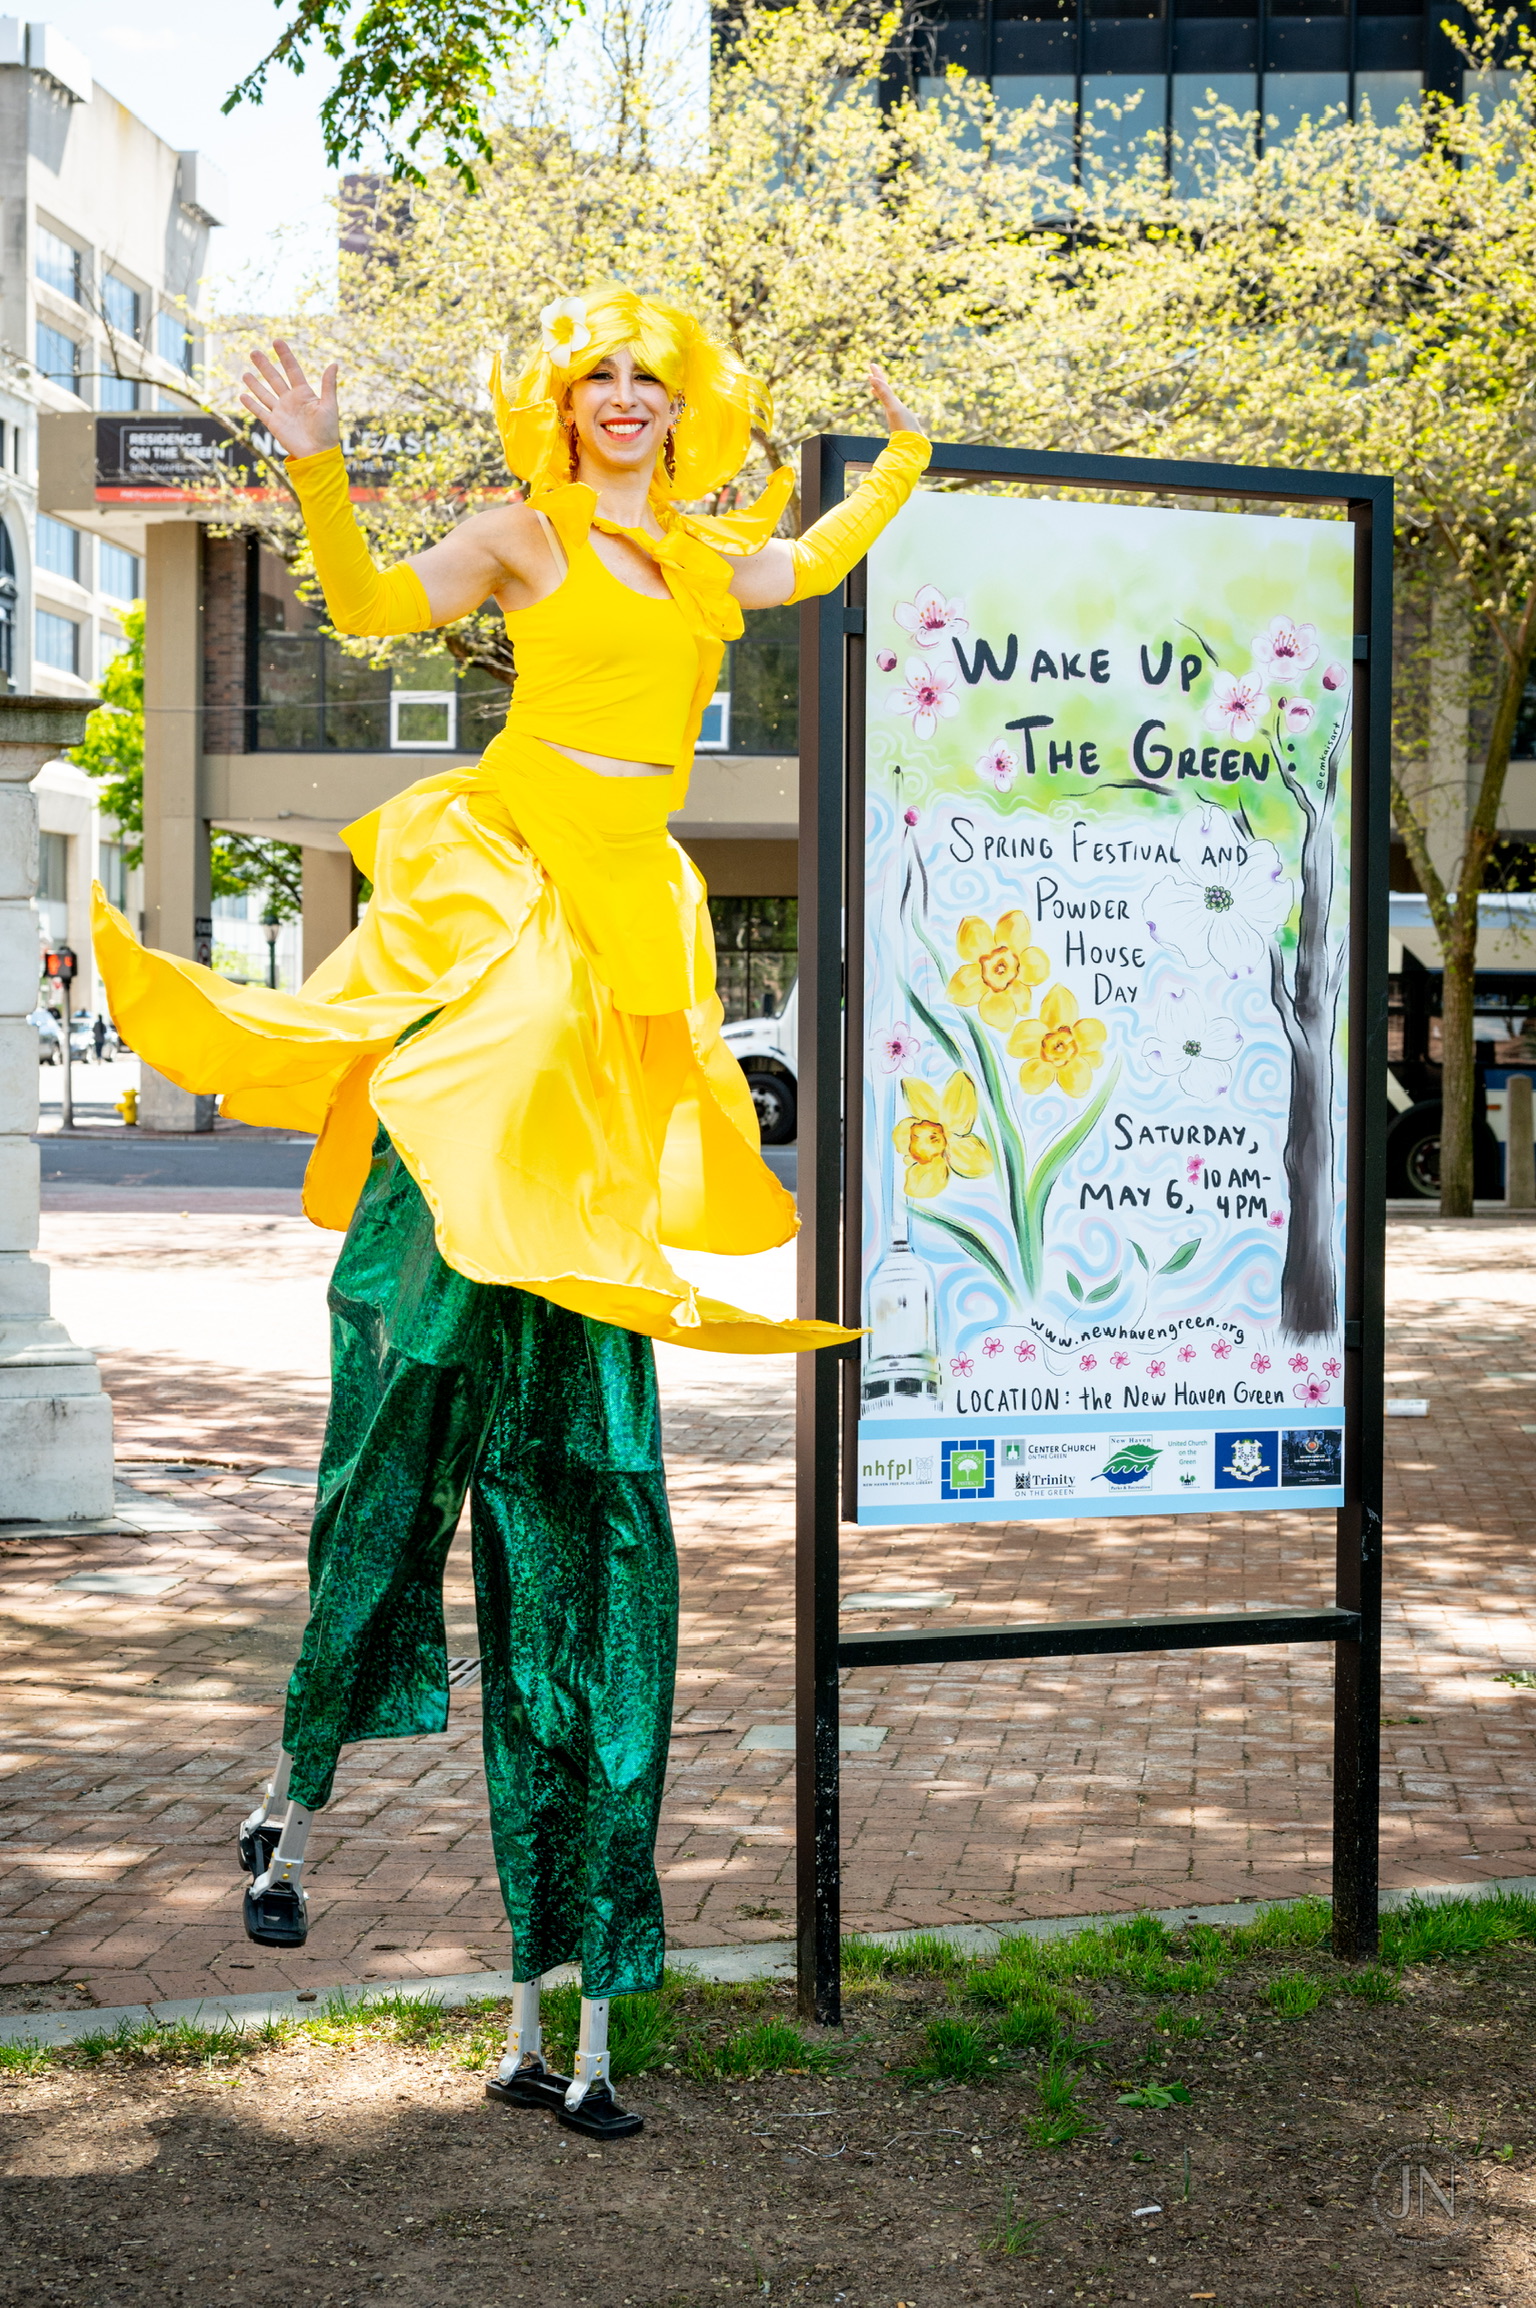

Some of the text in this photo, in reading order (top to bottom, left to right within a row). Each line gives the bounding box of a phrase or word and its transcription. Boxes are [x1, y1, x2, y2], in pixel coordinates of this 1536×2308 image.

[129, 433, 203, 446] RESIDENCE
[129, 447, 151, 460] ON
[152, 447, 179, 459] THE
[951, 633, 1202, 692] WAKE UP
[1005, 715, 1100, 775] THE
[1315, 721, 1341, 791] @emkaisart
[950, 817, 1249, 867] SPRING FESTIVAL AND
[1037, 876, 1131, 922] POWDER
[1066, 930, 1146, 968] HOUSE
[1094, 973, 1138, 1006] DAY
[1114, 1113, 1259, 1154] SATURDAY,
[1080, 1179, 1194, 1214] MAY 6,
[1030, 1315, 1245, 1348] www.newhavengreen.org
[956, 1380, 1285, 1414] LOCATION: the New Haven Green
[1028, 1443, 1096, 1453] CENTER CHURCH
[862, 1459, 912, 1480] nhfpl
[1032, 1474, 1076, 1488] Trinity
